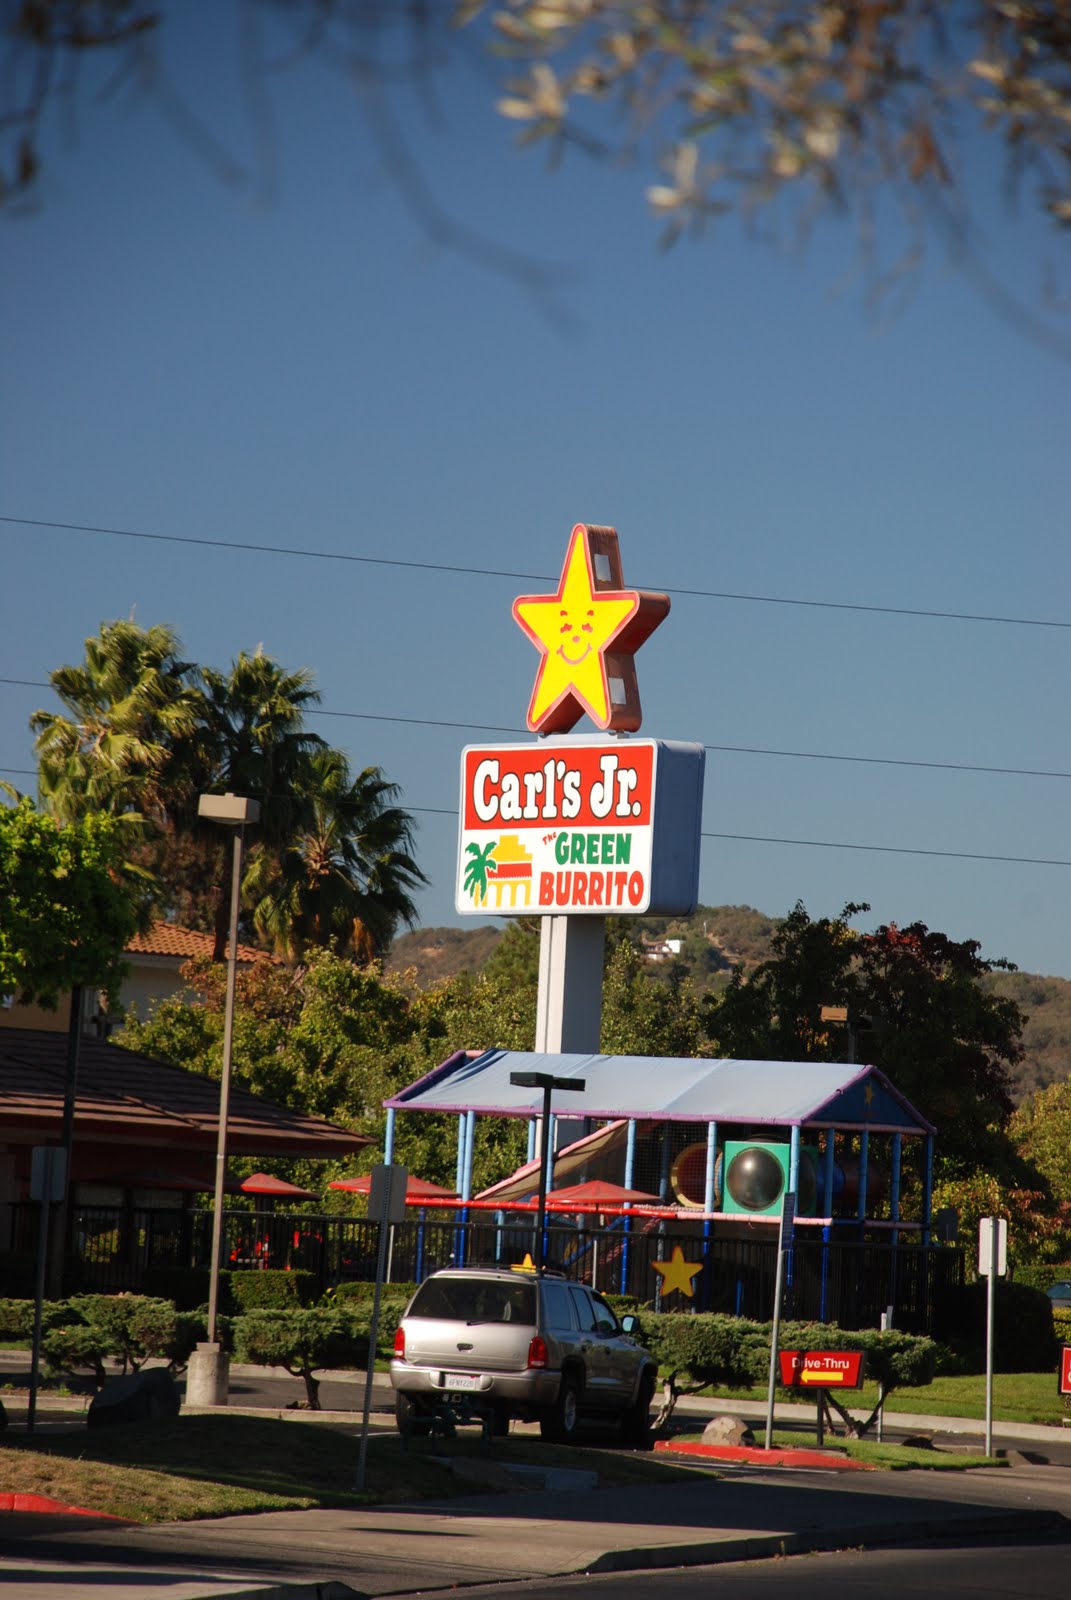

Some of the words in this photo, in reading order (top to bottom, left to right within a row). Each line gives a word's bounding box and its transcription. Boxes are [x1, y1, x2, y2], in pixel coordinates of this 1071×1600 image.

[473, 758, 582, 822] Carl's
[590, 754, 641, 819] Jr.
[542, 832, 557, 846] The
[555, 832, 632, 865] GREEN
[539, 870, 644, 906] BURRITO
[792, 1357, 849, 1369] Drive-Thru
